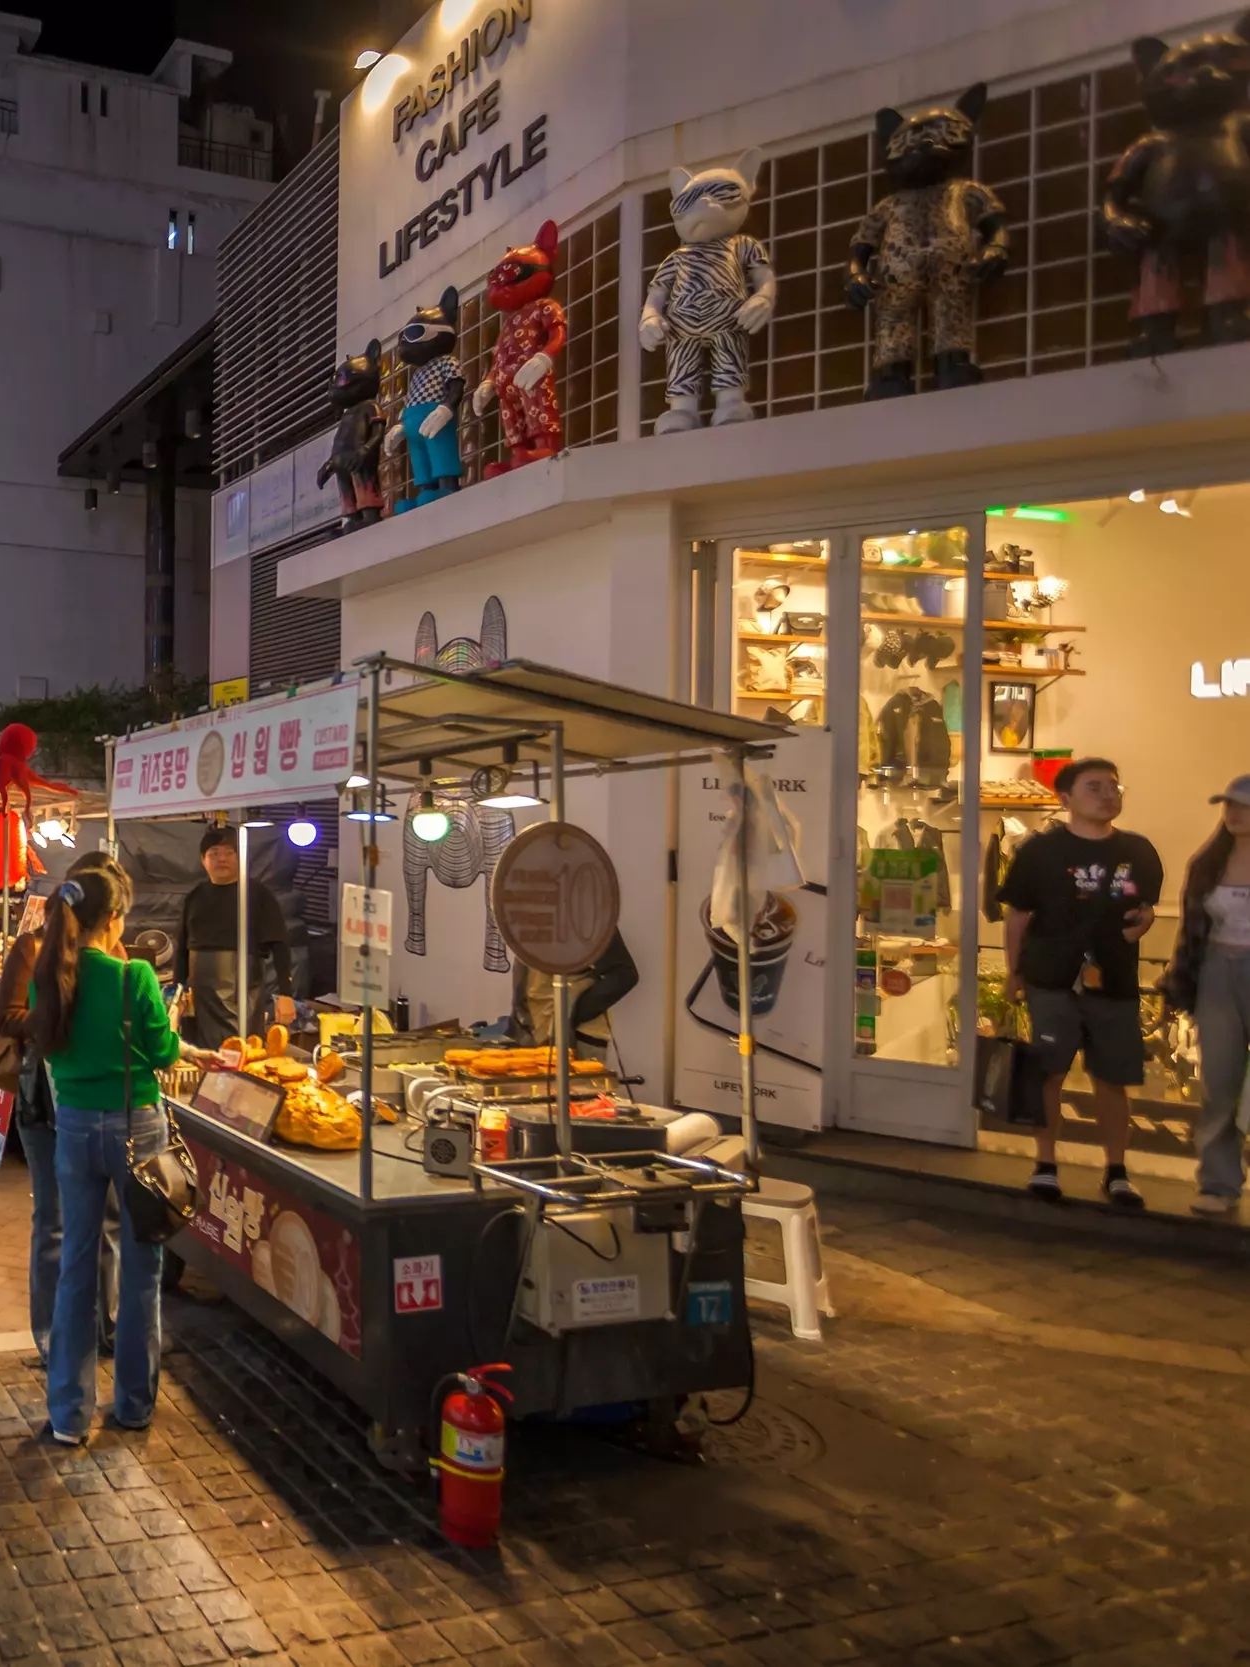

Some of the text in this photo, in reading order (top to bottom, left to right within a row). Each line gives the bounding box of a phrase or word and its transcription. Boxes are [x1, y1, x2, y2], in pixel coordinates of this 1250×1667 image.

[393, 0, 532, 143] FASHION
[415, 79, 500, 183] CAFE
[378, 113, 548, 280] LIFESTYLE
[702, 776, 807, 793] LIRK
[400, 1259, 435, 1276] 소화기
